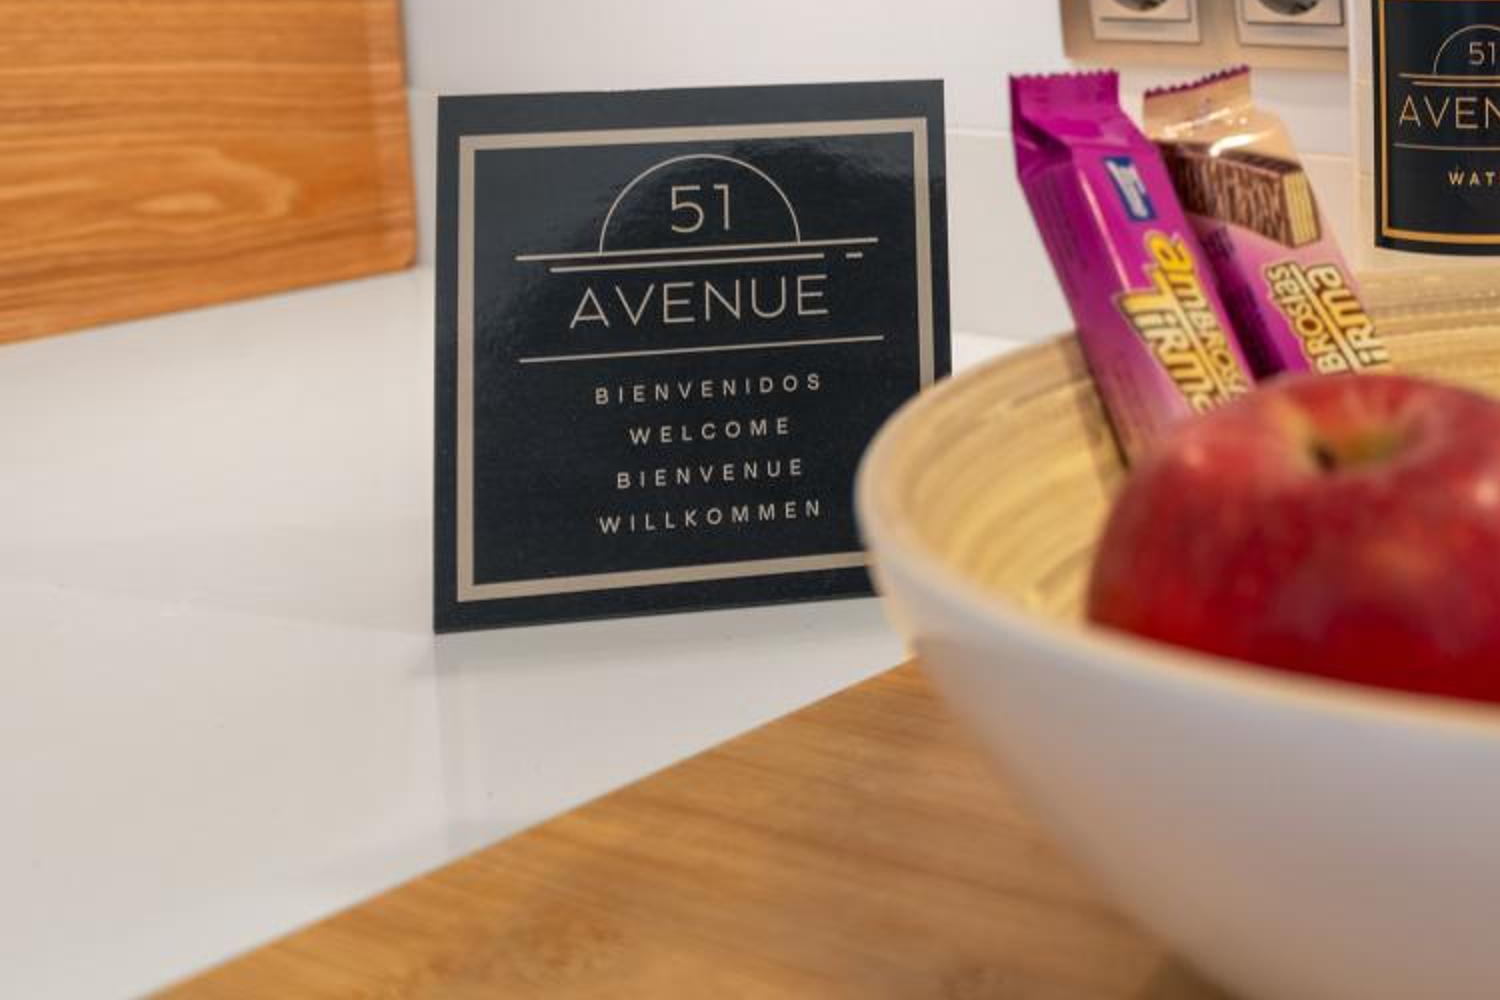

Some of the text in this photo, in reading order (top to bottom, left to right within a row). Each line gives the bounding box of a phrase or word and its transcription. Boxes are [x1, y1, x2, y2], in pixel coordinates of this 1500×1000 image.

[1469, 41, 1496, 66] 51
[671, 183, 731, 233] 51
[569, 273, 830, 329] AVENUE
[595, 373, 822, 406] BIENVENIDOS
[629, 416, 791, 446] WELCOME
[617, 457, 803, 490] BIENVENUE
[599, 499, 821, 535] WILLKOMMEN
